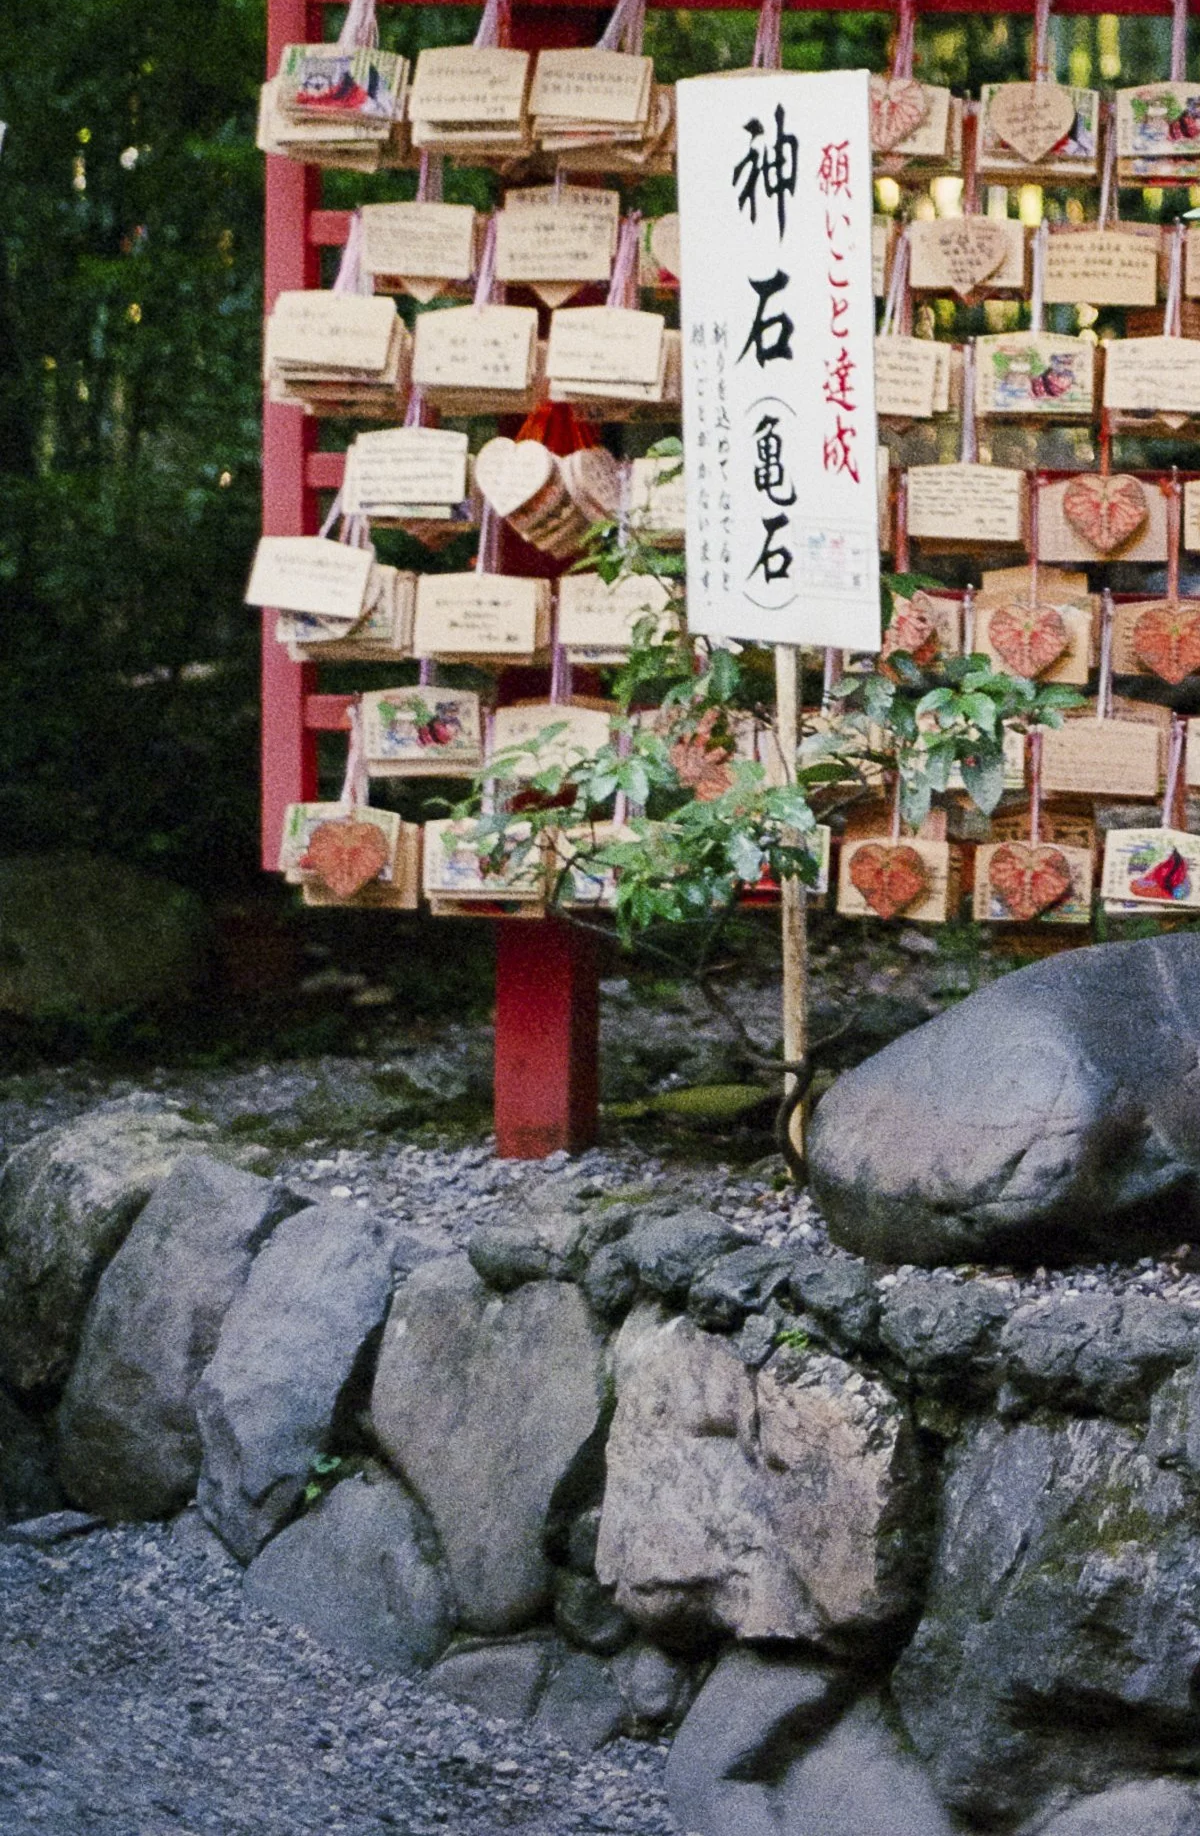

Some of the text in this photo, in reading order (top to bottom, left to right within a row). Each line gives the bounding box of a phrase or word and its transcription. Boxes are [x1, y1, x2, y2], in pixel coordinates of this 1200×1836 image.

[817, 140, 861, 484] 願いごと達成
